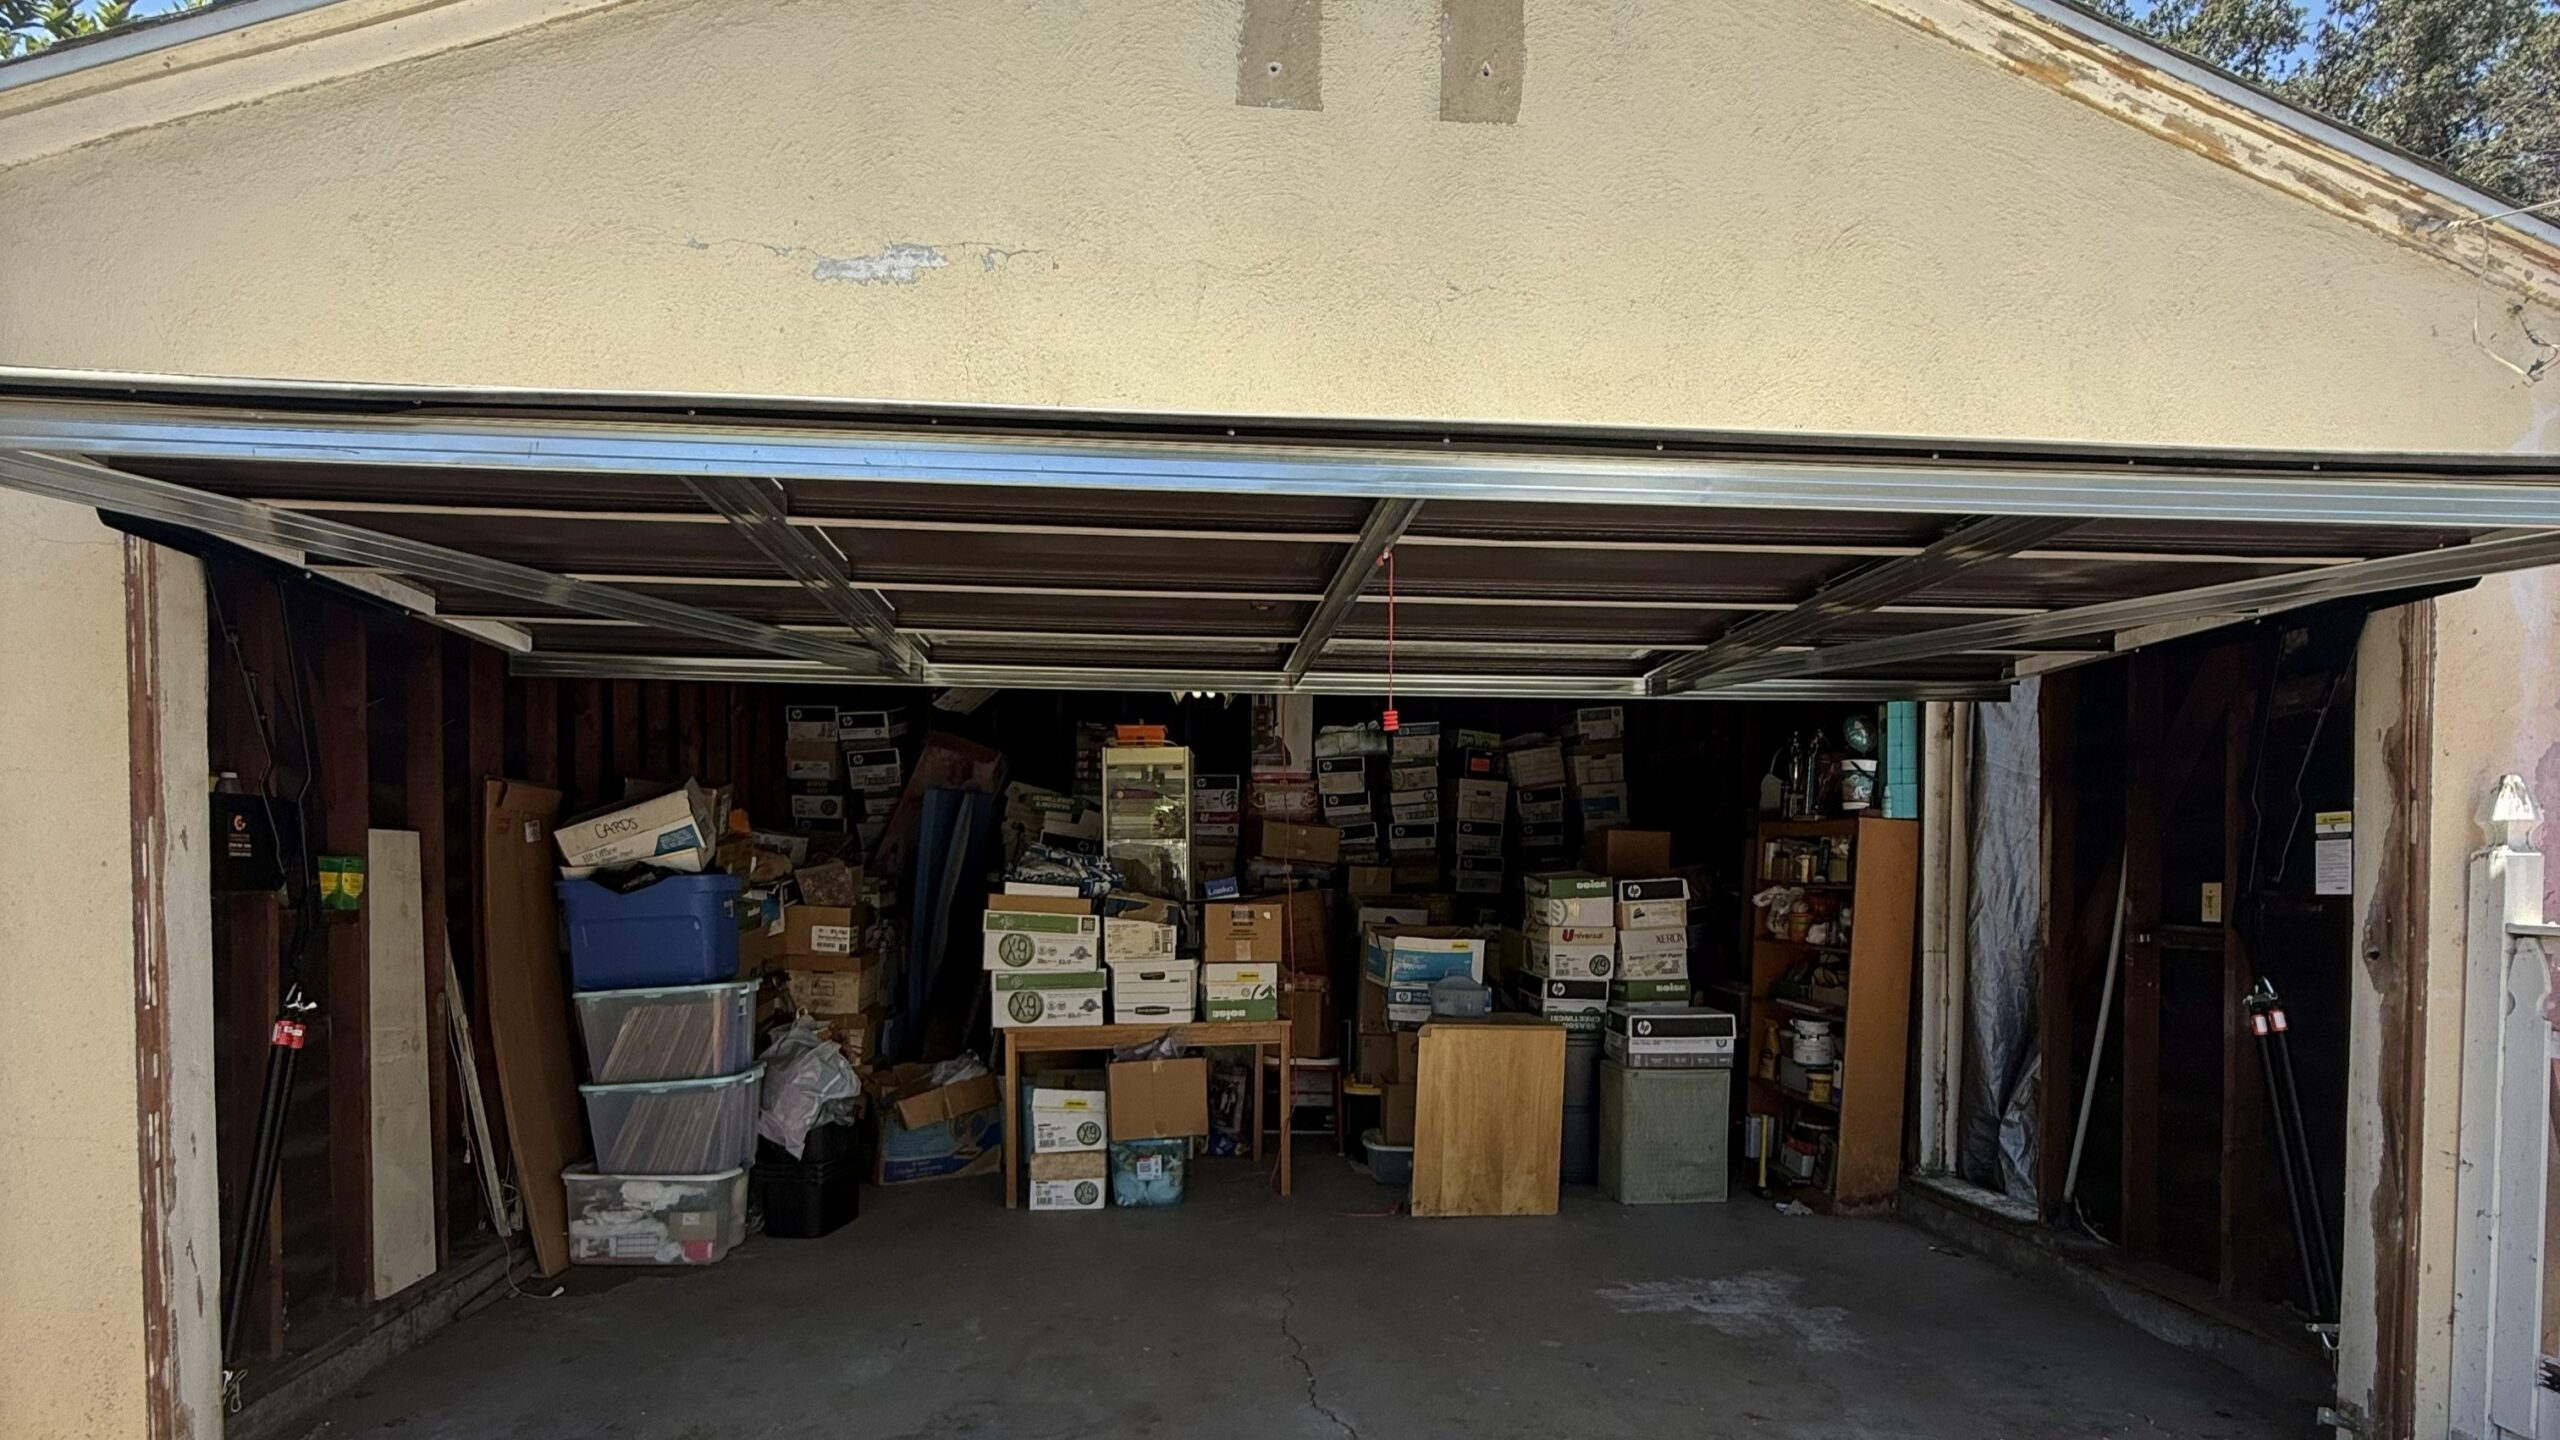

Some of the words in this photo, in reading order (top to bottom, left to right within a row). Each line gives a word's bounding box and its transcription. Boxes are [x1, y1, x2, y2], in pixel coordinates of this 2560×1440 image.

[594, 818, 638, 838] CARDS
[1562, 929, 1604, 942] Universal
[1638, 1020, 1652, 1036] hp
